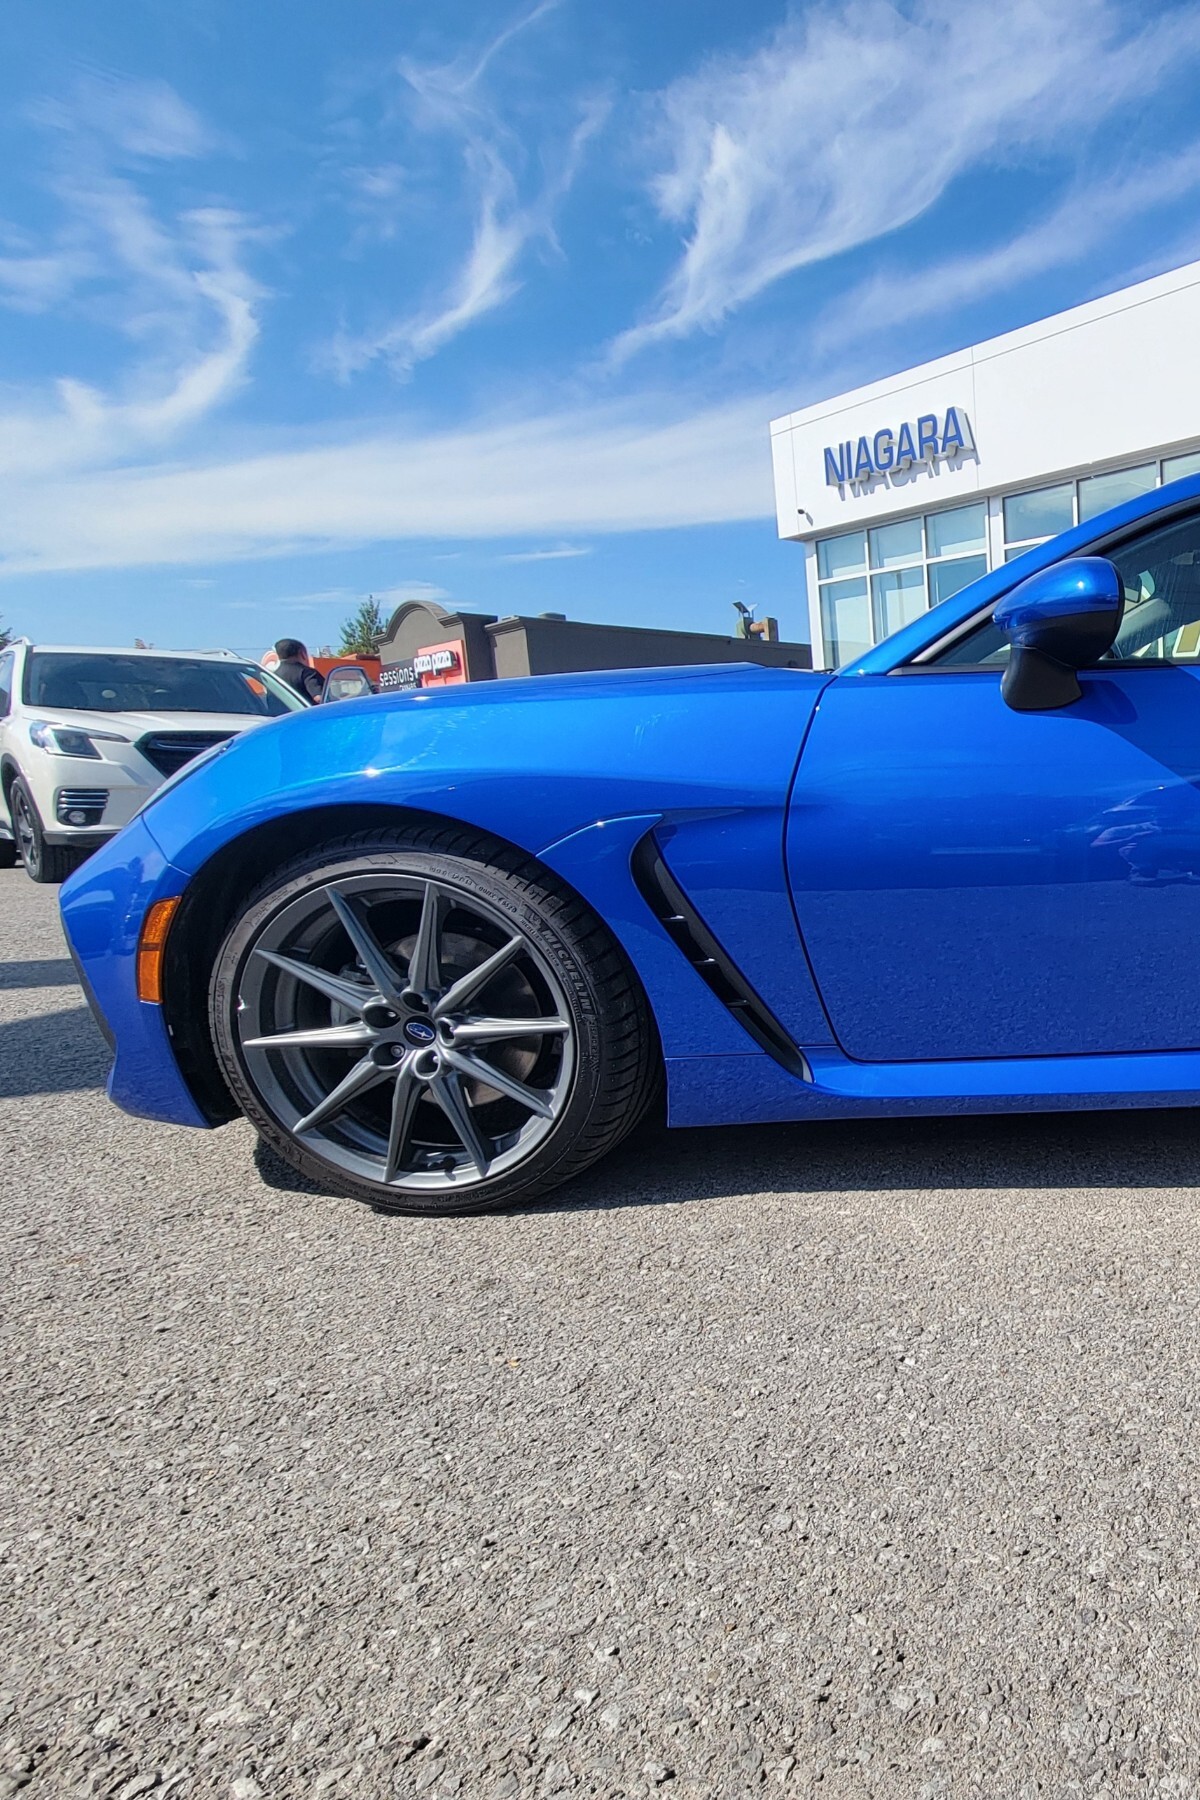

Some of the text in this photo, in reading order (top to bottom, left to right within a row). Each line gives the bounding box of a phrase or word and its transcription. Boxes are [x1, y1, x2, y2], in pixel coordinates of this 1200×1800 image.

[823, 406, 965, 486] NIAGARA
[379, 667, 414, 687] sessions
[541, 928, 594, 1016] MICHELIN
